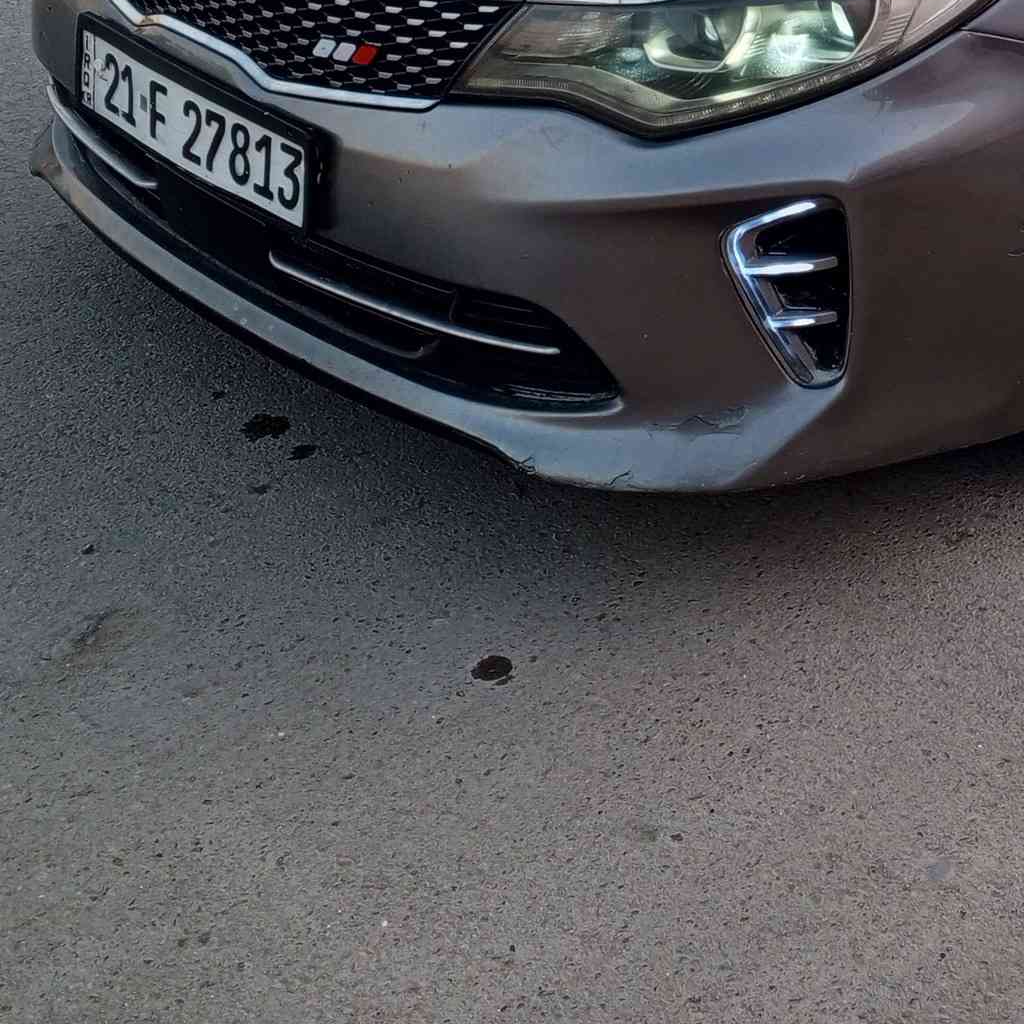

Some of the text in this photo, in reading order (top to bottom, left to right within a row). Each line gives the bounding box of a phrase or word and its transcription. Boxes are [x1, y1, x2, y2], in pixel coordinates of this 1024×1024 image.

[104, 53, 303, 211] 21 F 27813
